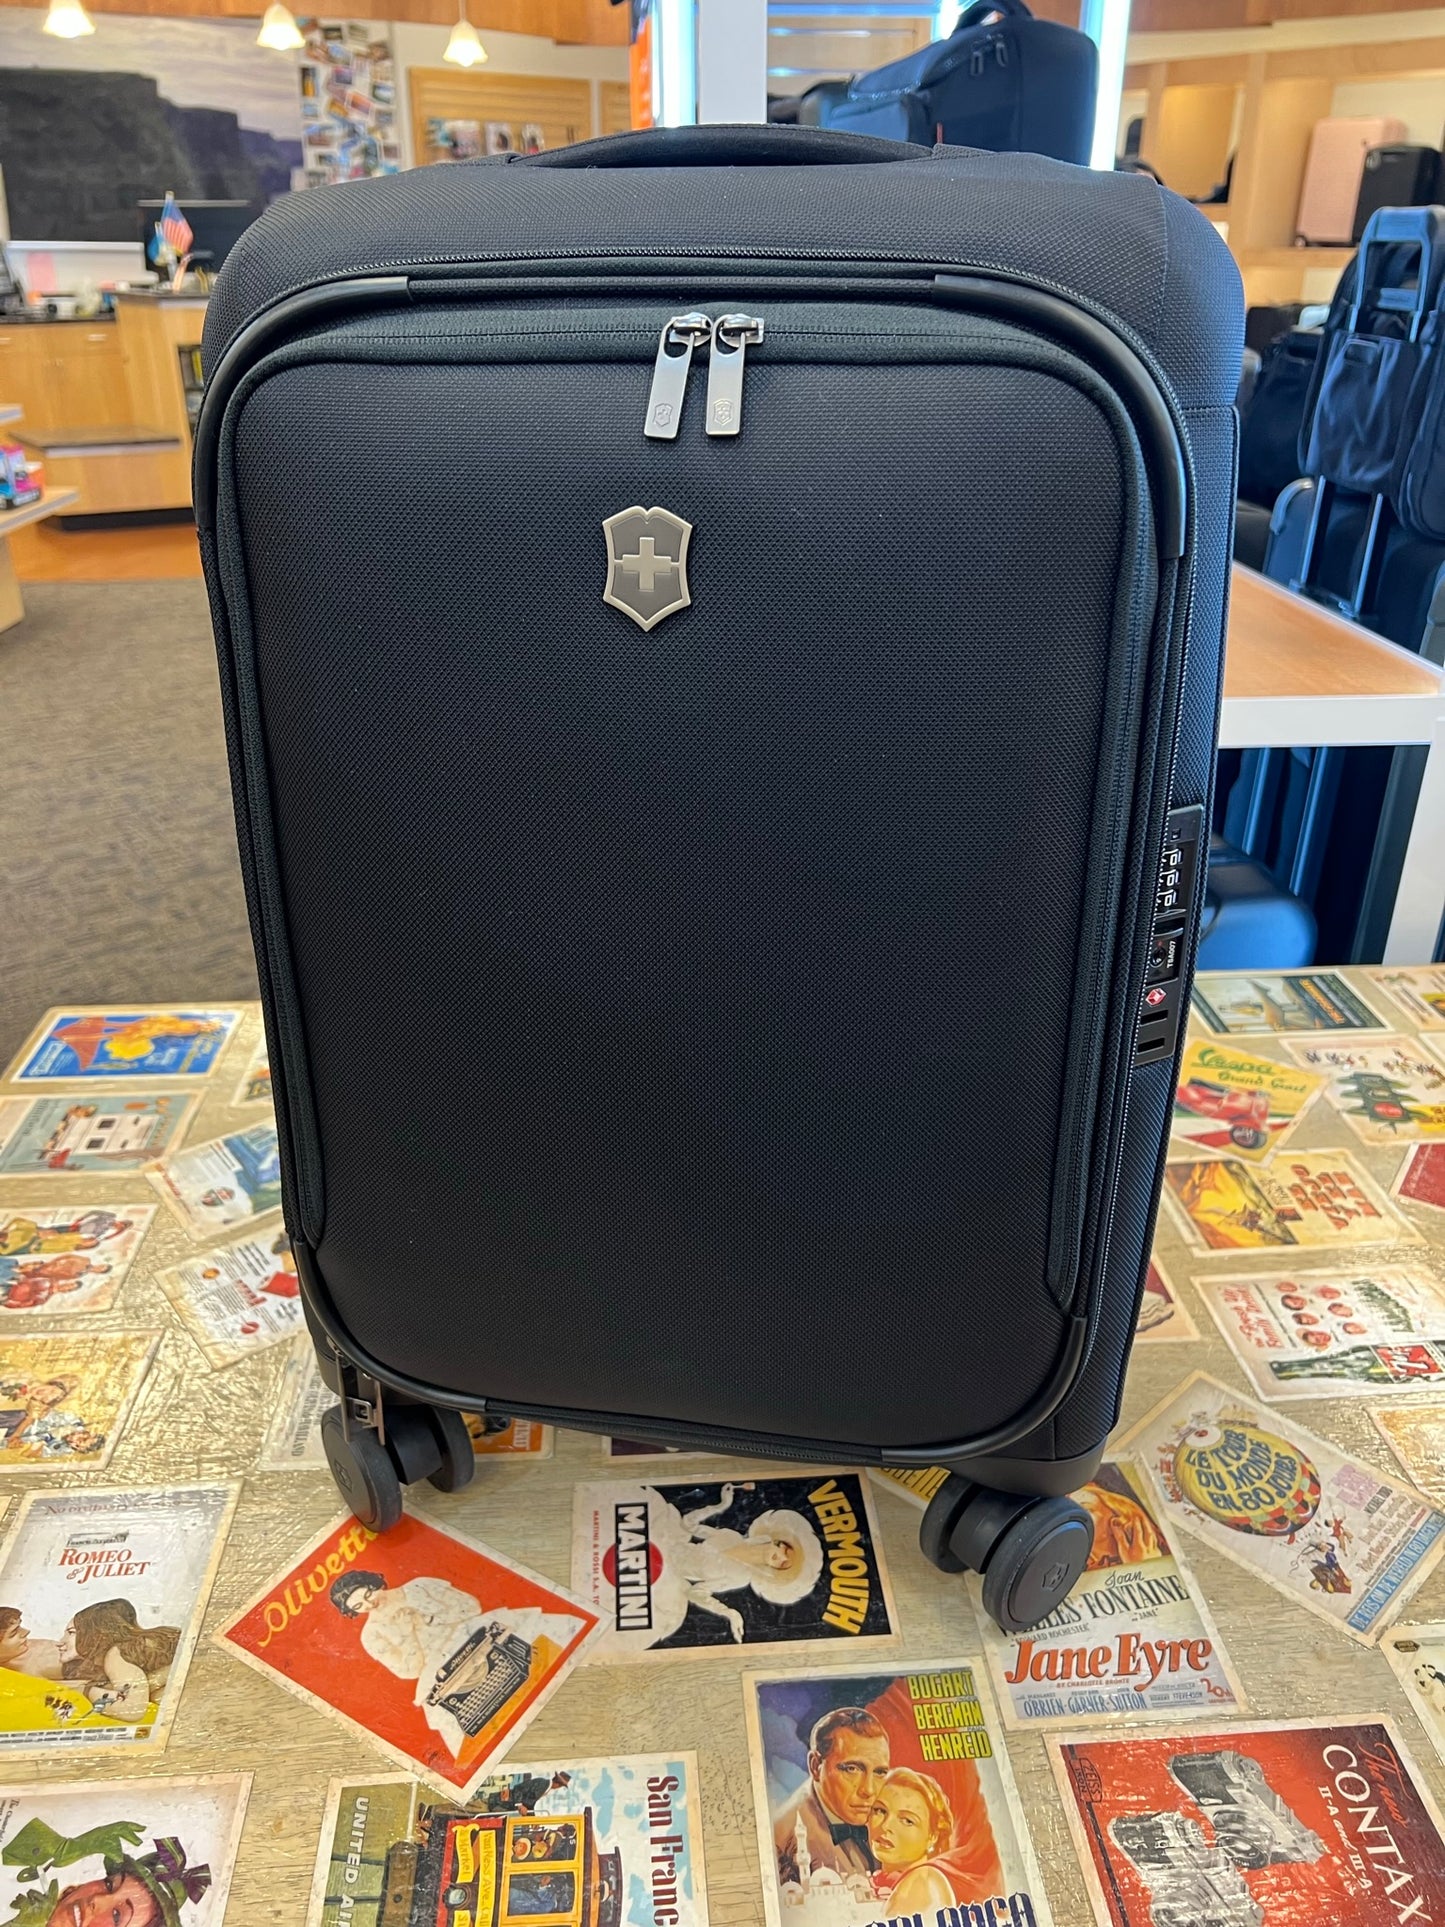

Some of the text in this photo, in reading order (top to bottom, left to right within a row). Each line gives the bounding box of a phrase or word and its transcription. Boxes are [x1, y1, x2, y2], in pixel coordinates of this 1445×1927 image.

[1185, 1428, 1248, 1470] LE TOUR
[1198, 1439, 1272, 1491] DU MONDE
[1210, 1451, 1298, 1512] EN 80 JOURS
[592, 1510, 601, 1541] MARTINI
[58, 1547, 134, 1566] ROMEO
[78, 1561, 151, 1584] JULIET
[592, 1551, 600, 1574] ROSSI
[617, 1505, 649, 1628] MARTINI
[805, 1478, 872, 1635] VERMOUTH
[1082, 1574, 1190, 1620] FONTAINE
[1104, 1570, 1146, 1590] Joan
[1004, 1632, 1213, 1692] Jane Eyre
[905, 1671, 974, 1701] BOGART
[1110, 1693, 1148, 1712] SUTTON
[912, 1699, 985, 1731] BERGMAN
[919, 1728, 993, 1762] HENREID
[1358, 1742, 1412, 1781] The
[1083, 1764, 1101, 1796] ZEISS
[645, 1775, 680, 1828] San
[343, 1796, 370, 1885] UNITED
[1321, 1744, 1434, 1925] CONTAX
[1331, 1818, 1359, 1853] and
